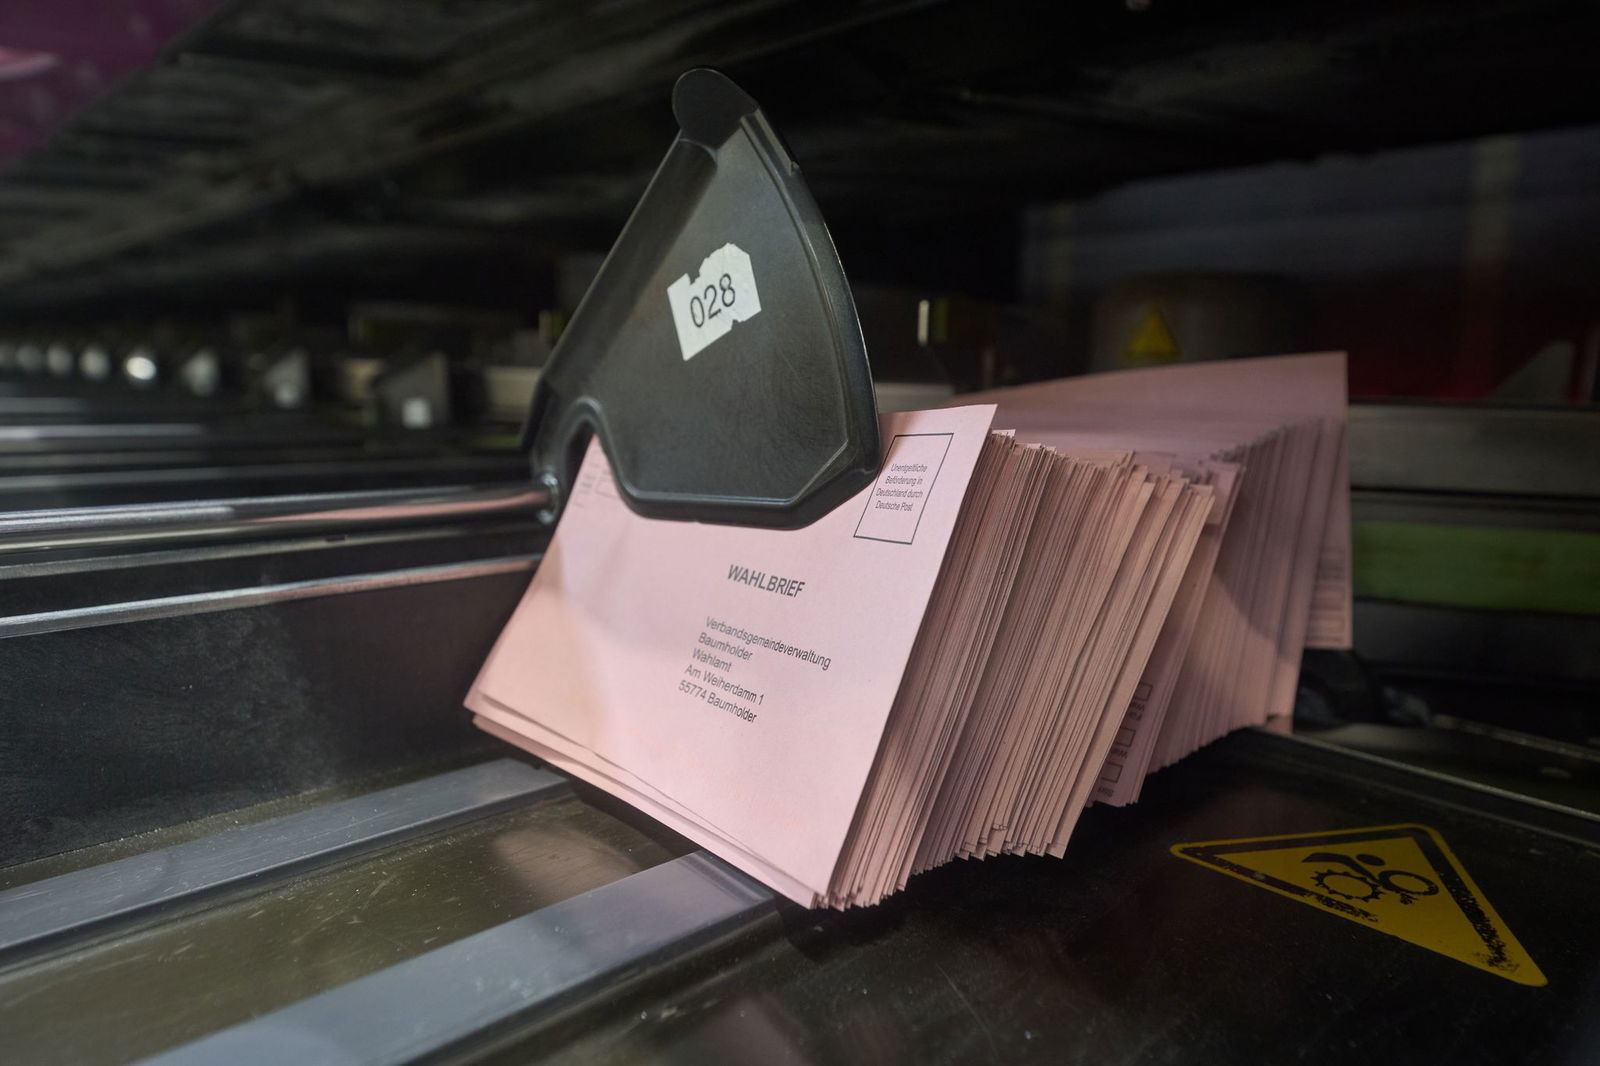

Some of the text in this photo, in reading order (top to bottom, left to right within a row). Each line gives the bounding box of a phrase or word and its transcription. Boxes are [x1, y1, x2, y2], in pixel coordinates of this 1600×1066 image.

[690, 273, 736, 328] 028
[884, 475, 923, 487] Beförderung in
[890, 463, 928, 473] Unentgeltliche
[875, 487, 924, 498] Deutschland durch
[875, 500, 914, 512] Deutsche Post
[727, 564, 806, 598] WAHLBRIEF
[697, 631, 753, 661] Baumholder
[705, 615, 832, 671] Verbandsgemeindeverwaltung
[691, 647, 733, 673] Wahlamt
[684, 663, 765, 706] Am Weiherdamm 1
[678, 679, 757, 724] 55774 Baumholder
